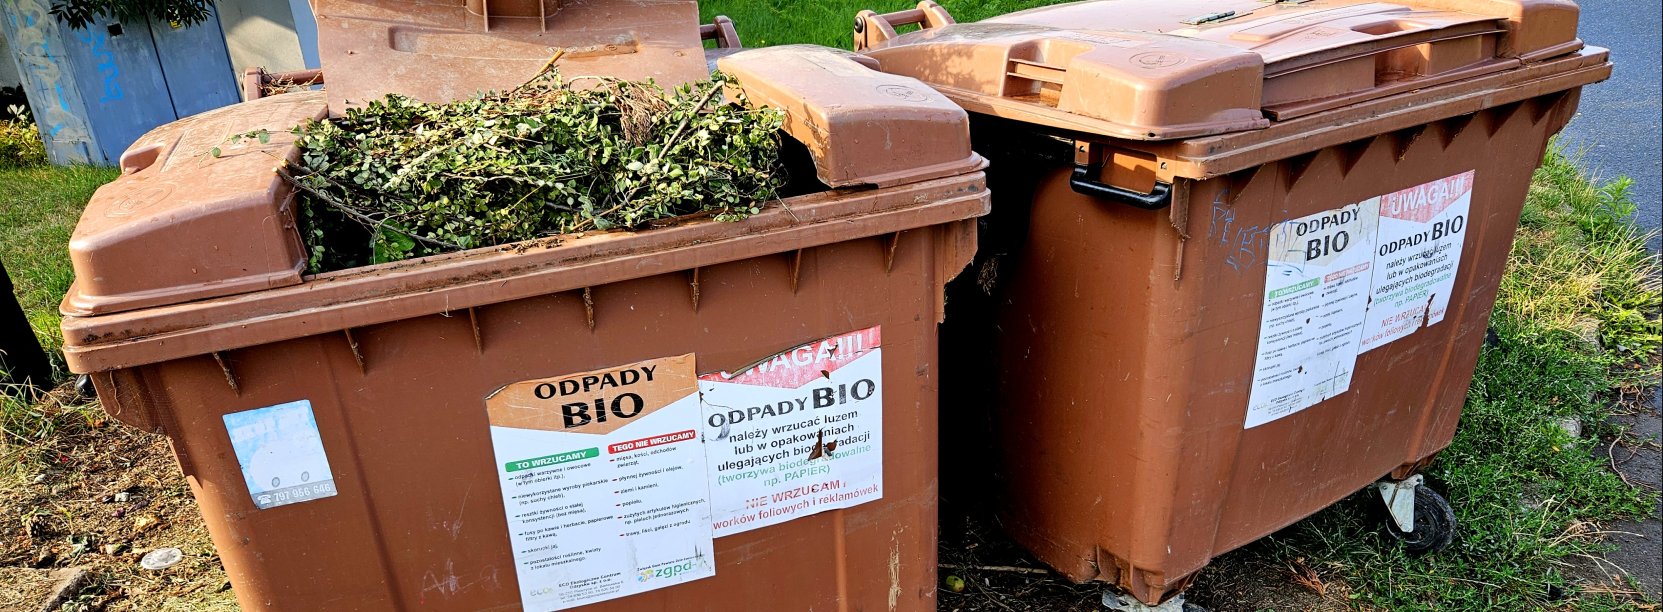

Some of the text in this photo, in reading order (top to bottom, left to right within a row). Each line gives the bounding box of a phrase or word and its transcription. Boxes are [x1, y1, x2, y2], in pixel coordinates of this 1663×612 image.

[1391, 177, 1464, 215] UWAGA!!!
[1296, 207, 1360, 236] ODPADY
[1306, 231, 1349, 261] BIO
[1379, 215, 1464, 257] ODPADY BIO
[1386, 257, 1406, 270] należy
[1387, 271, 1396, 280] lub
[1405, 254, 1447, 275] opakowaniach
[1376, 276, 1412, 295] ulegających
[1414, 261, 1453, 282] biodegradacji
[1395, 305, 1426, 322] WRZUCA
[534, 365, 656, 399] ODPADY
[562, 392, 644, 429] BIO
[708, 378, 876, 428] ODPADY BIO
[729, 409, 858, 446] należy wrzucać luzem
[612, 432, 694, 452] TEGO NIE WRZUCAMY
[650, 447, 676, 455] odchodów
[718, 431, 870, 474] ulegających bioadacji
[735, 443, 753, 455] lub
[757, 443, 767, 451] w
[515, 451, 587, 470] TO WRZUCAMY
[537, 468, 562, 477] warzywne
[567, 463, 591, 471] owocowe
[639, 469, 661, 478] żywności
[718, 464, 775, 486] (tworzywa
[763, 464, 830, 488] np. PAPIER)
[274, 491, 290, 501] 797
[313, 483, 330, 494] 646
[518, 479, 608, 501] niewykorzystane wyroby piekarskie
[530, 496, 546, 504] suchy
[745, 478, 847, 510] NIE WRZUCAM
[539, 506, 563, 515] żywności
[712, 512, 755, 530] worków
[759, 499, 809, 520] foliowych
[819, 483, 878, 505] reklamówek
[588, 515, 613, 525] papierowe
